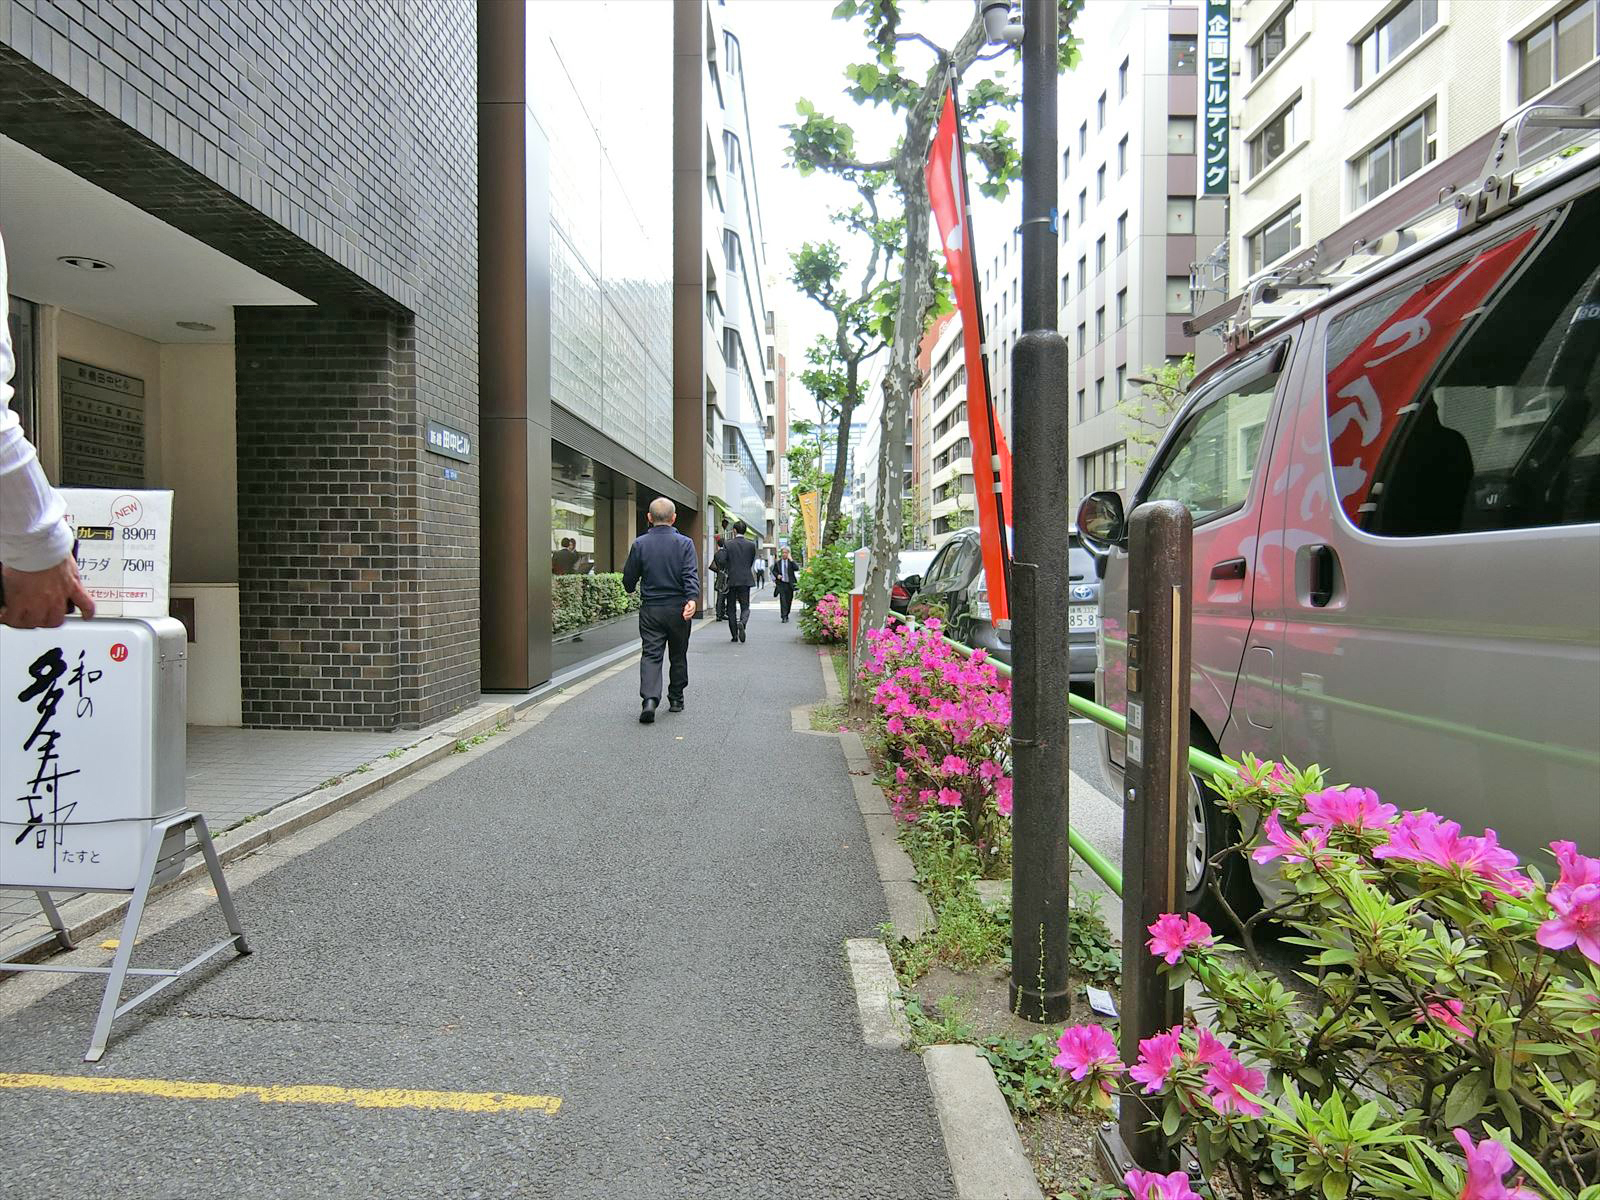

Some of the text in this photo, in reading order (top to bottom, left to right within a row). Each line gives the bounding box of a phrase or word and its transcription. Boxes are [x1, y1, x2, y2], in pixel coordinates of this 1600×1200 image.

[1207, 0, 1229, 187] 企画ビルディング
[114, 502, 138, 519] NEW
[122, 527, 156, 541] 890円
[121, 558, 154, 572] 750円
[1070, 615, 1095, 626] 85-8
[62, 850, 101, 864] たすと
